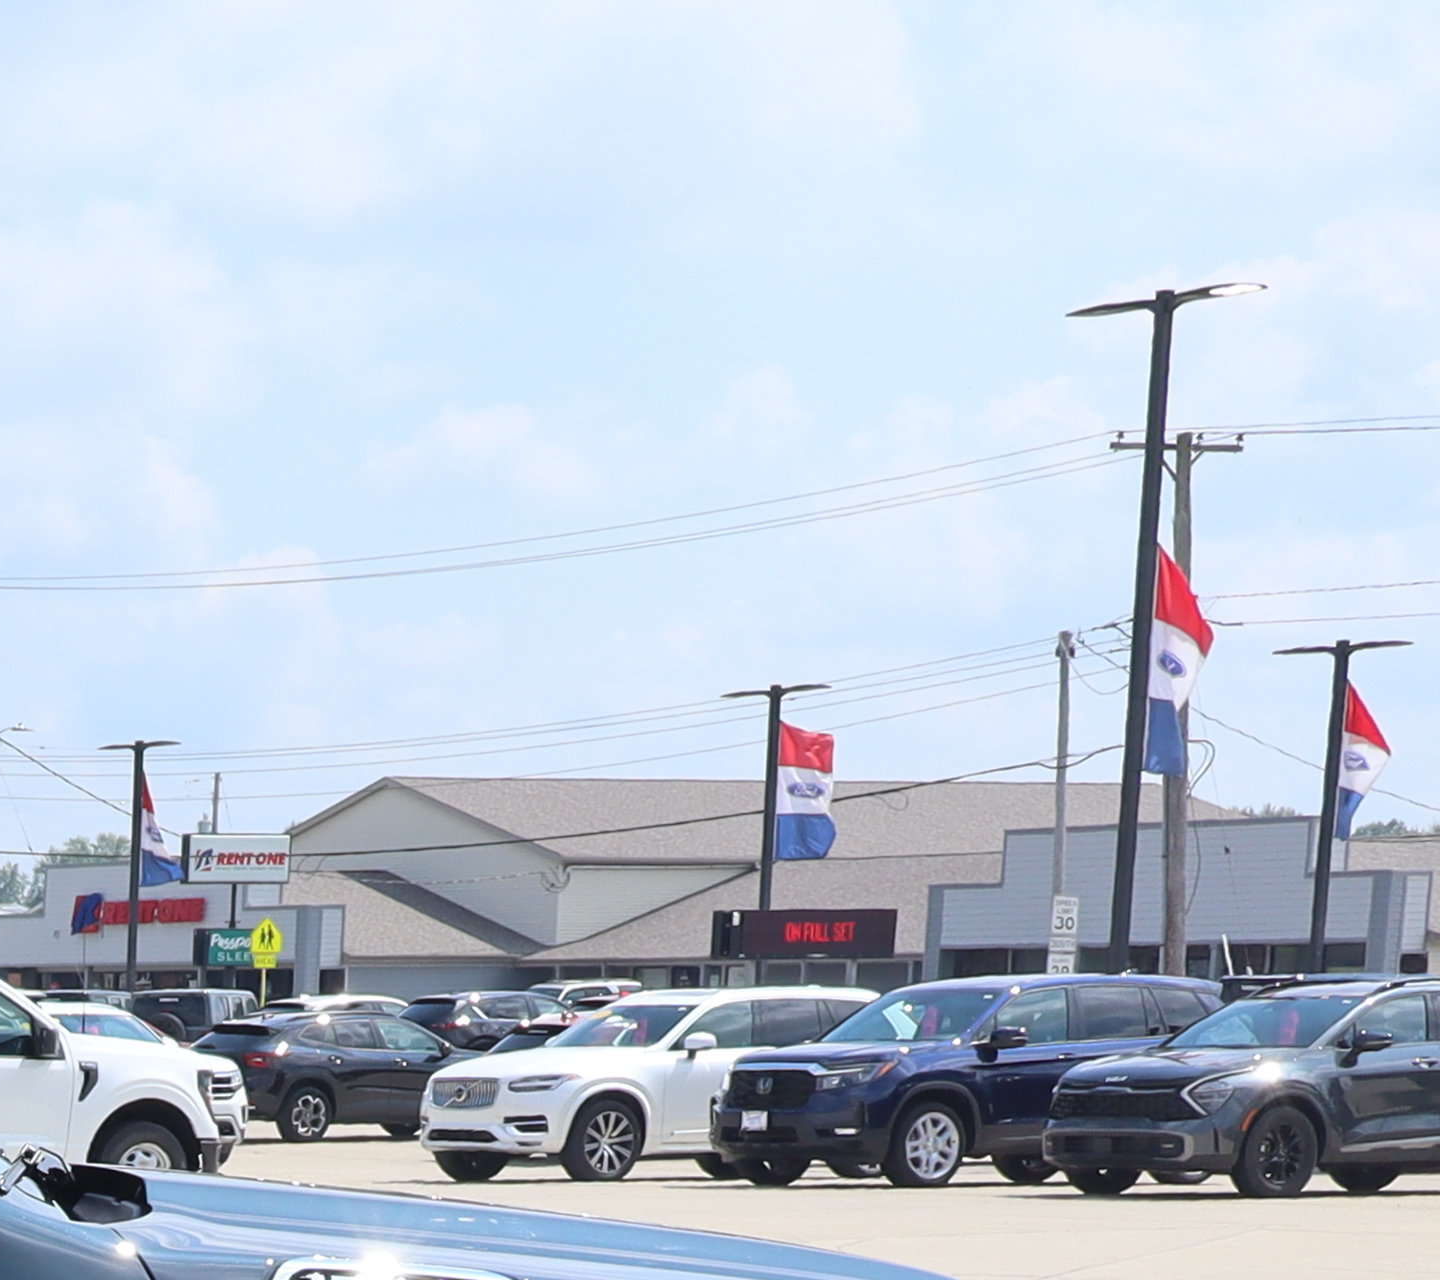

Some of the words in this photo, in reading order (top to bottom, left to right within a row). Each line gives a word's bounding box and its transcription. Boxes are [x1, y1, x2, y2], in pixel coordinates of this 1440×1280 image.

[216, 852, 254, 866] RENT
[255, 852, 288, 866] ONE
[1054, 916, 1076, 930] 30
[832, 922, 857, 942] SET
[216, 951, 251, 962] SLEE
